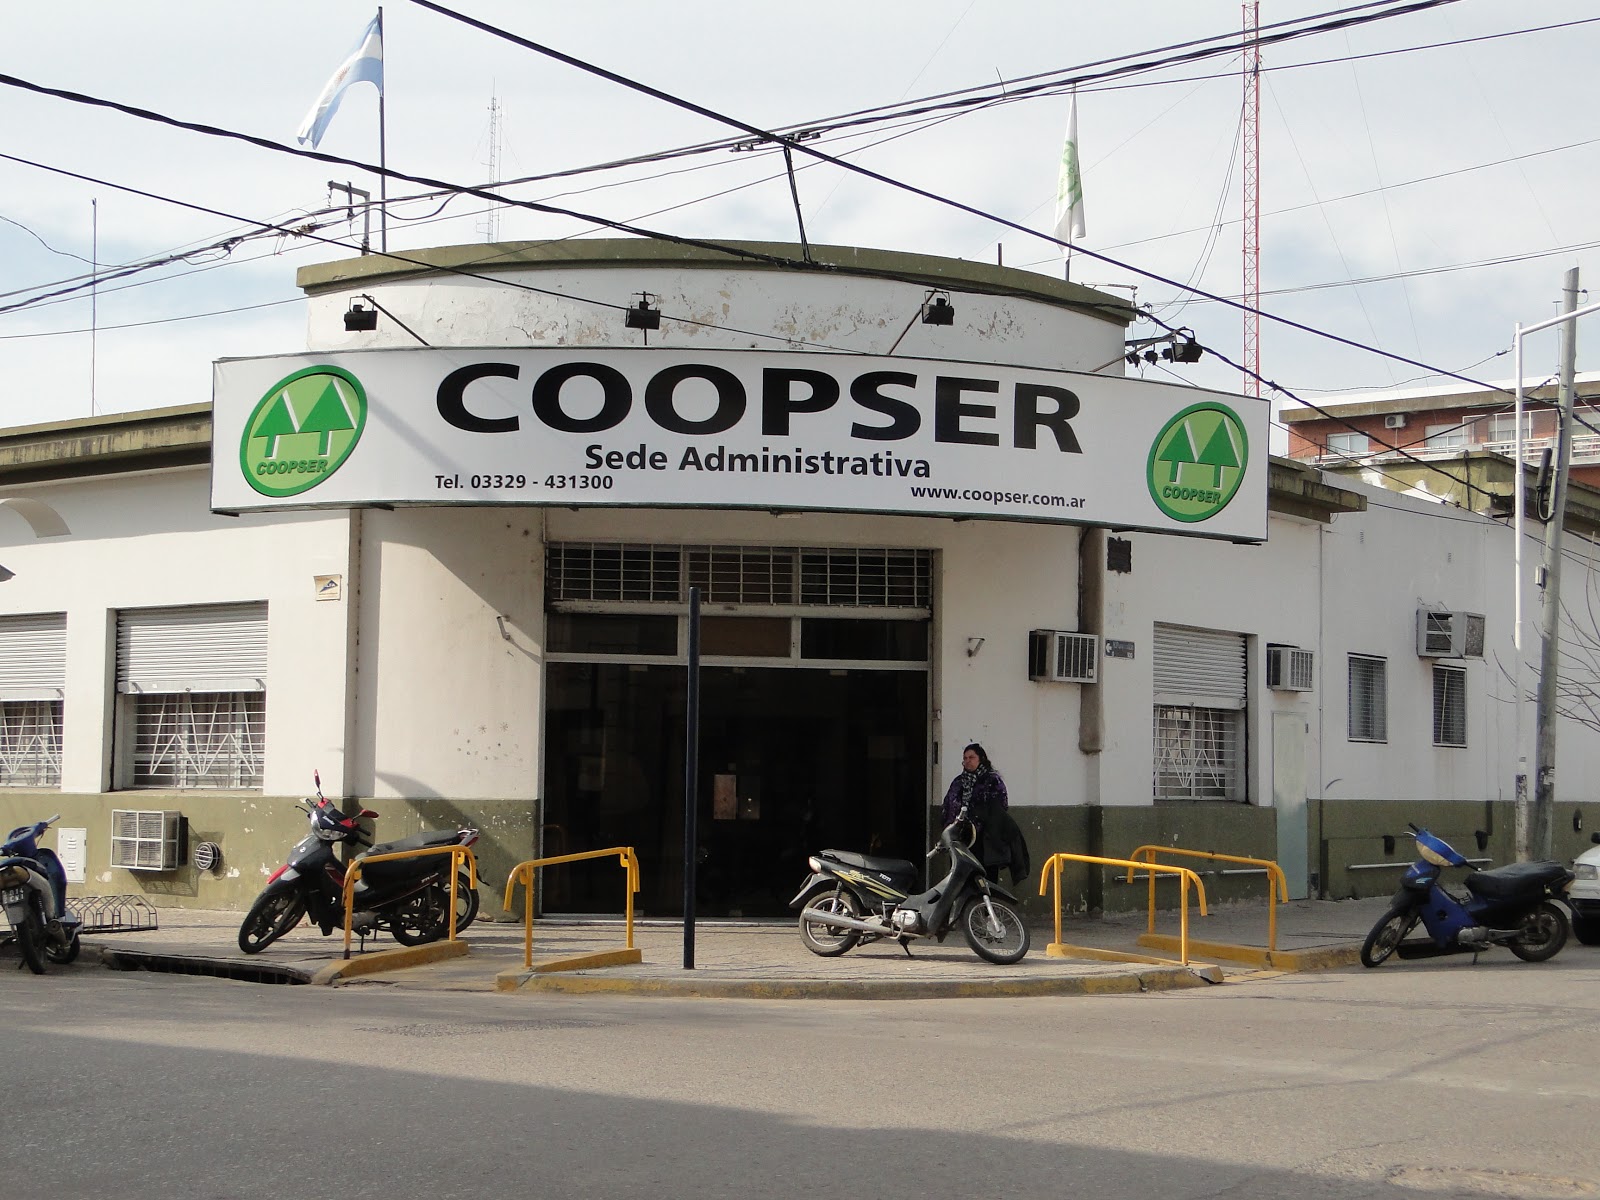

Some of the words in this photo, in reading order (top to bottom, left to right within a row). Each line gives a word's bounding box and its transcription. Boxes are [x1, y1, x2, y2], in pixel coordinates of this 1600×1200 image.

[436, 362, 1083, 454] COOPSER
[256, 459, 328, 475] COOPSER
[586, 444, 668, 471] Sede
[678, 446, 930, 478] Administrativa
[435, 474, 464, 489] Tel.
[470, 474, 527, 489] 03329
[544, 474, 614, 489] 431300
[911, 485, 1086, 509] www.coopser.com.ar
[1163, 485, 1221, 504] COOPSER
